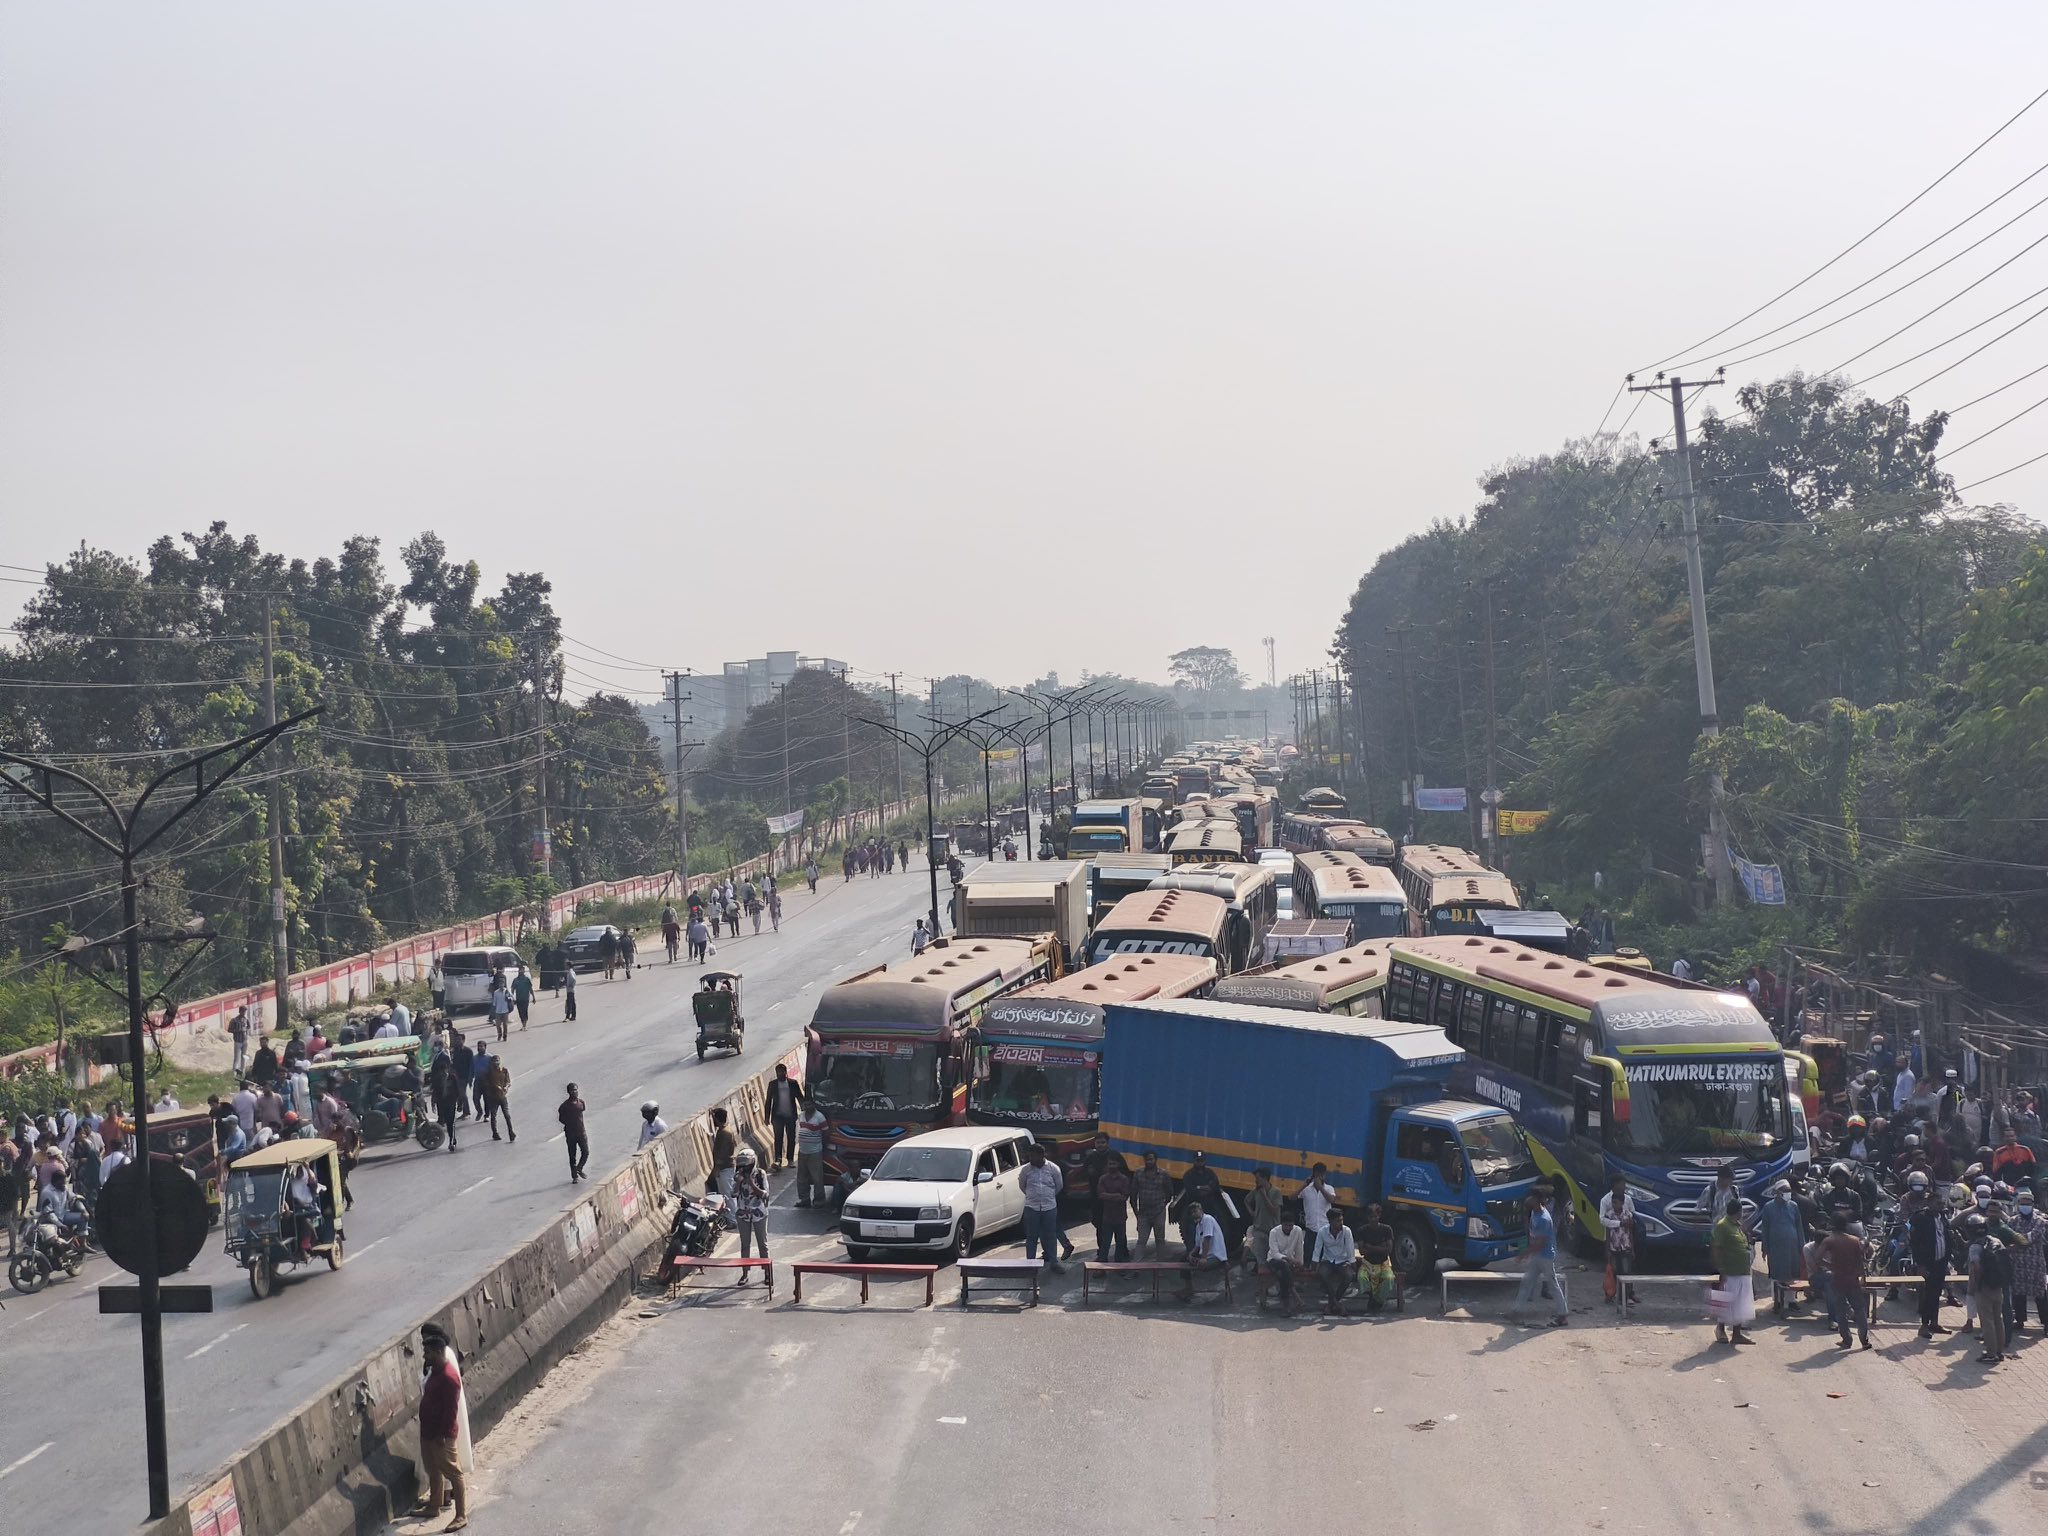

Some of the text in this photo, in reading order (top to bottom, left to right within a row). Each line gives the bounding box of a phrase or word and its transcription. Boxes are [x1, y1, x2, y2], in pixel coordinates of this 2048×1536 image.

[993, 1043, 1045, 1062] ইতিহাস
[1625, 1063, 1775, 1082] HATIKUMRUL EXPRESS
[1705, 1082, 1752, 1092] ঢাকা-বগুড়া
